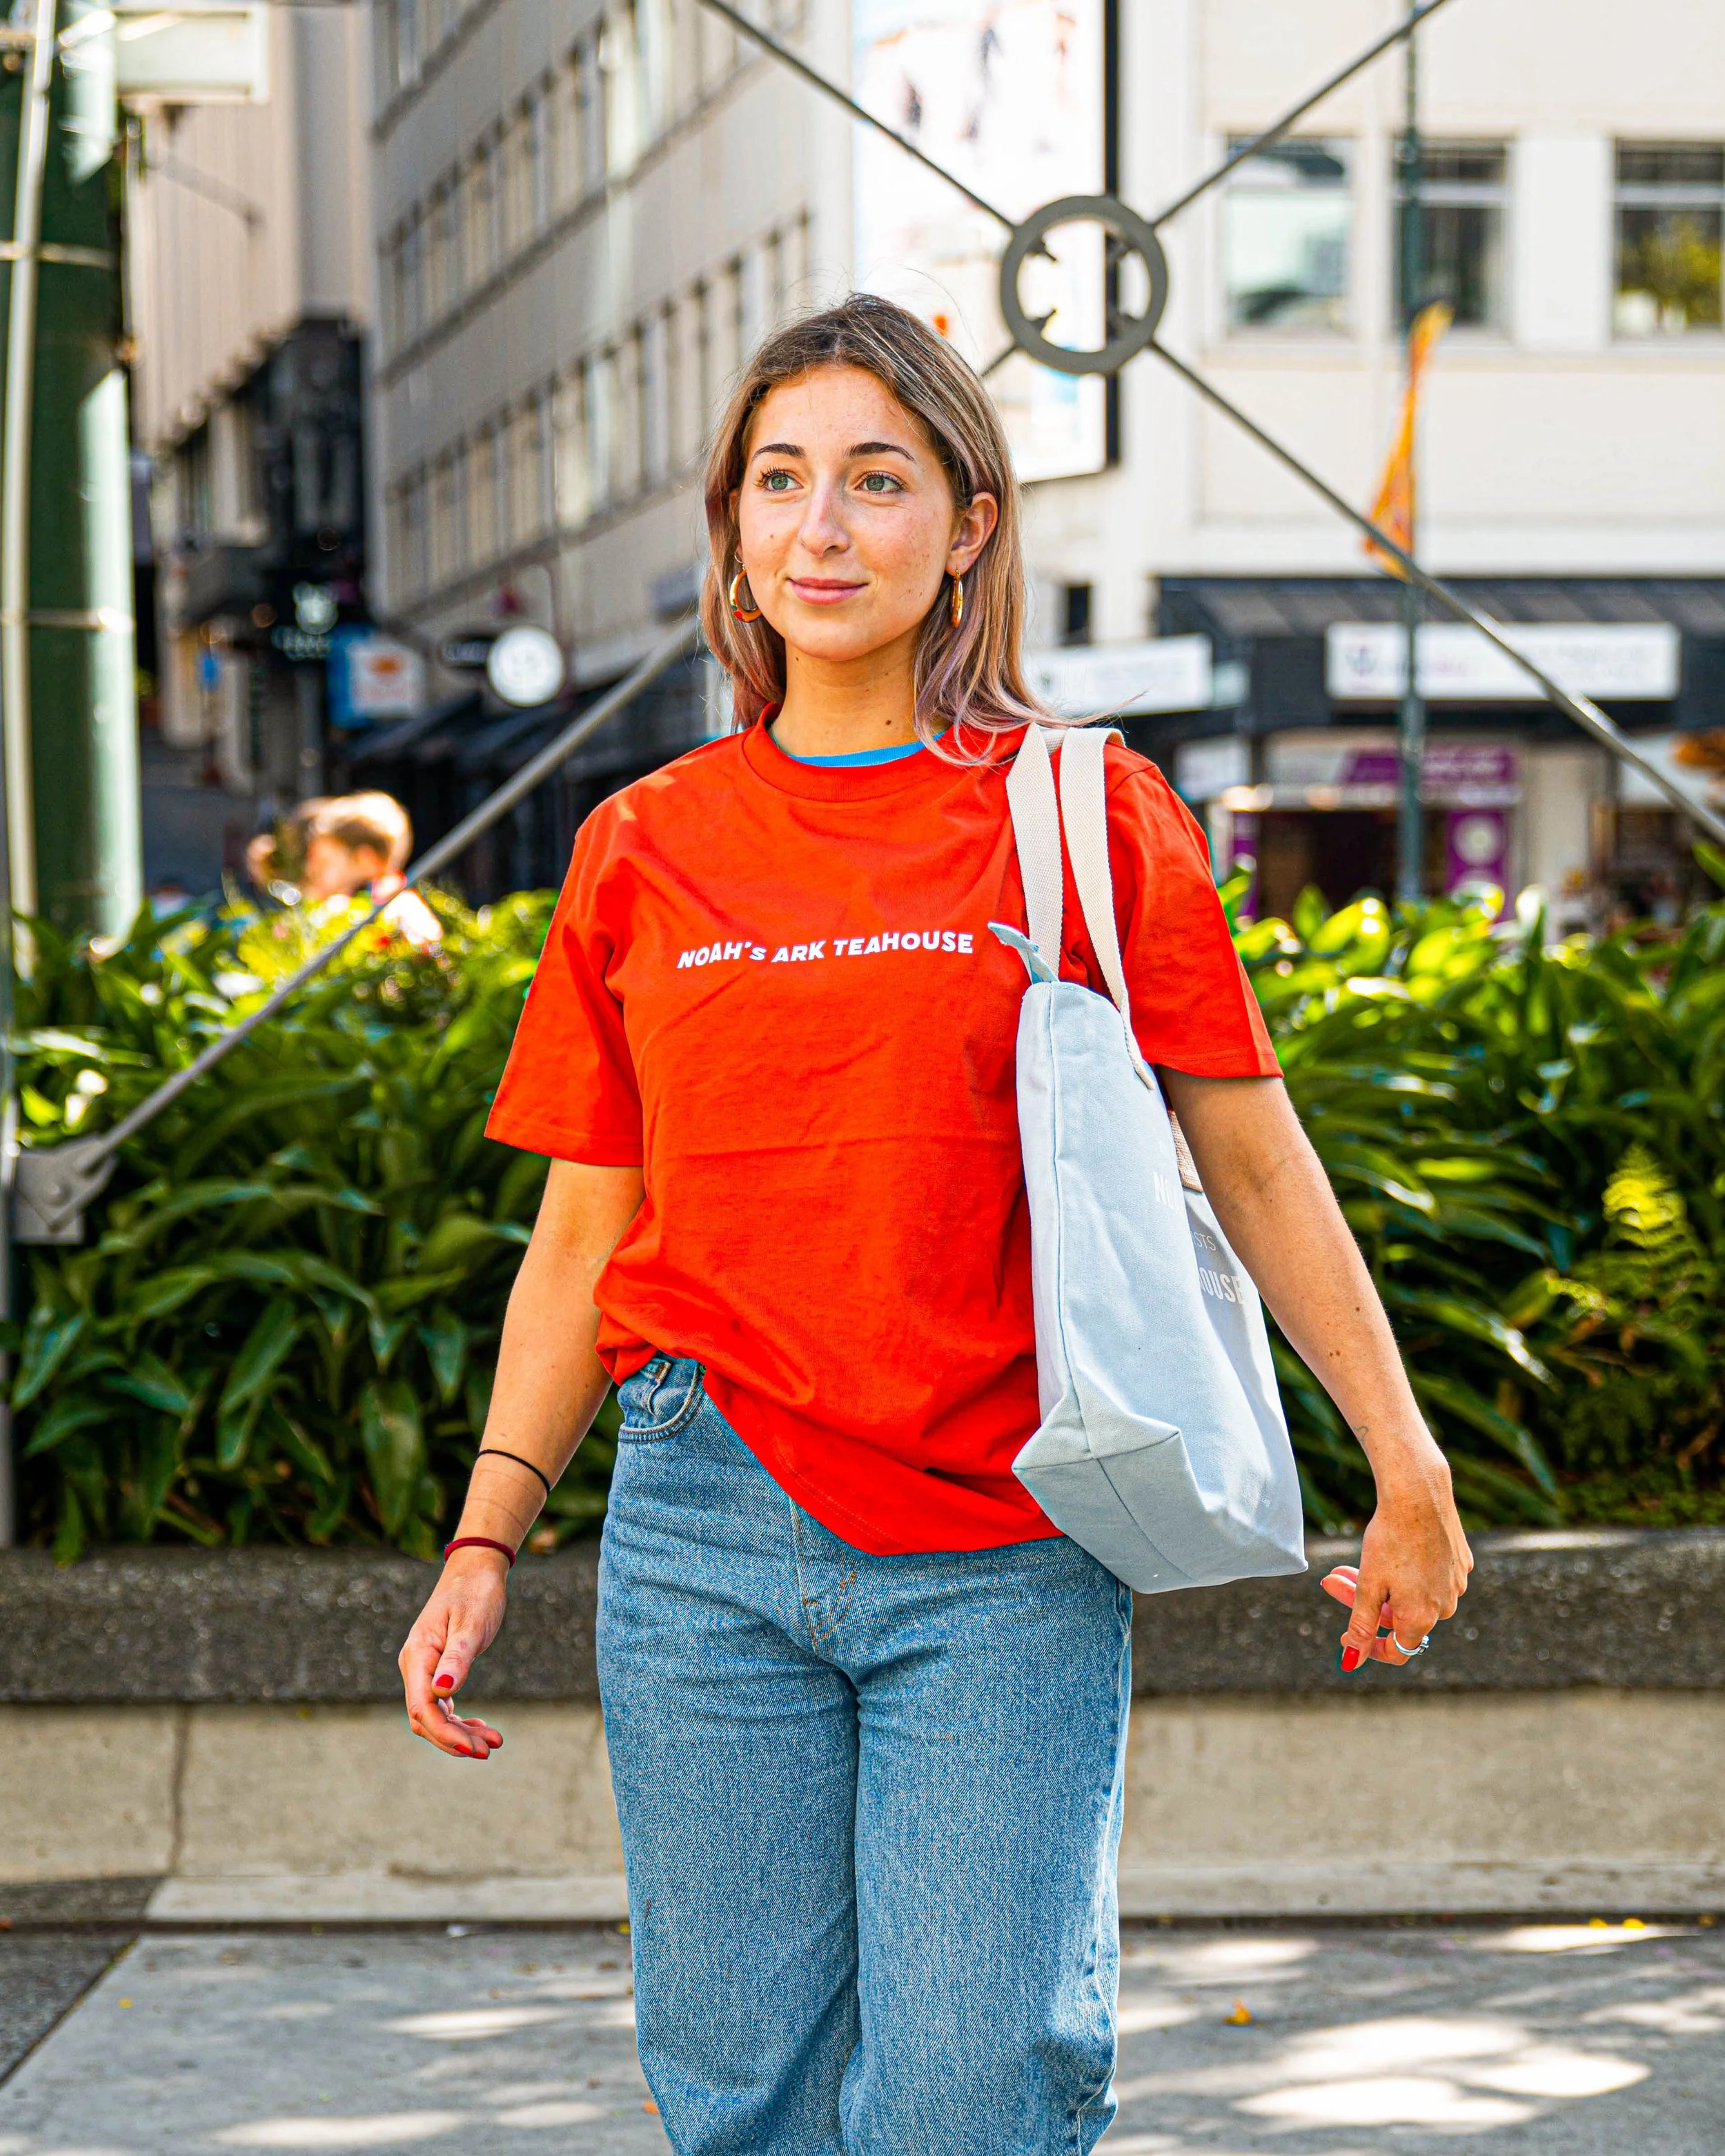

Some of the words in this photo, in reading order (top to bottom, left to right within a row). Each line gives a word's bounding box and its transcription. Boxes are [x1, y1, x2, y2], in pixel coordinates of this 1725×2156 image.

[677, 941, 767, 968] NOAH's
[771, 940, 826, 963] ARK
[834, 931, 974, 956] TEAHOUSE
